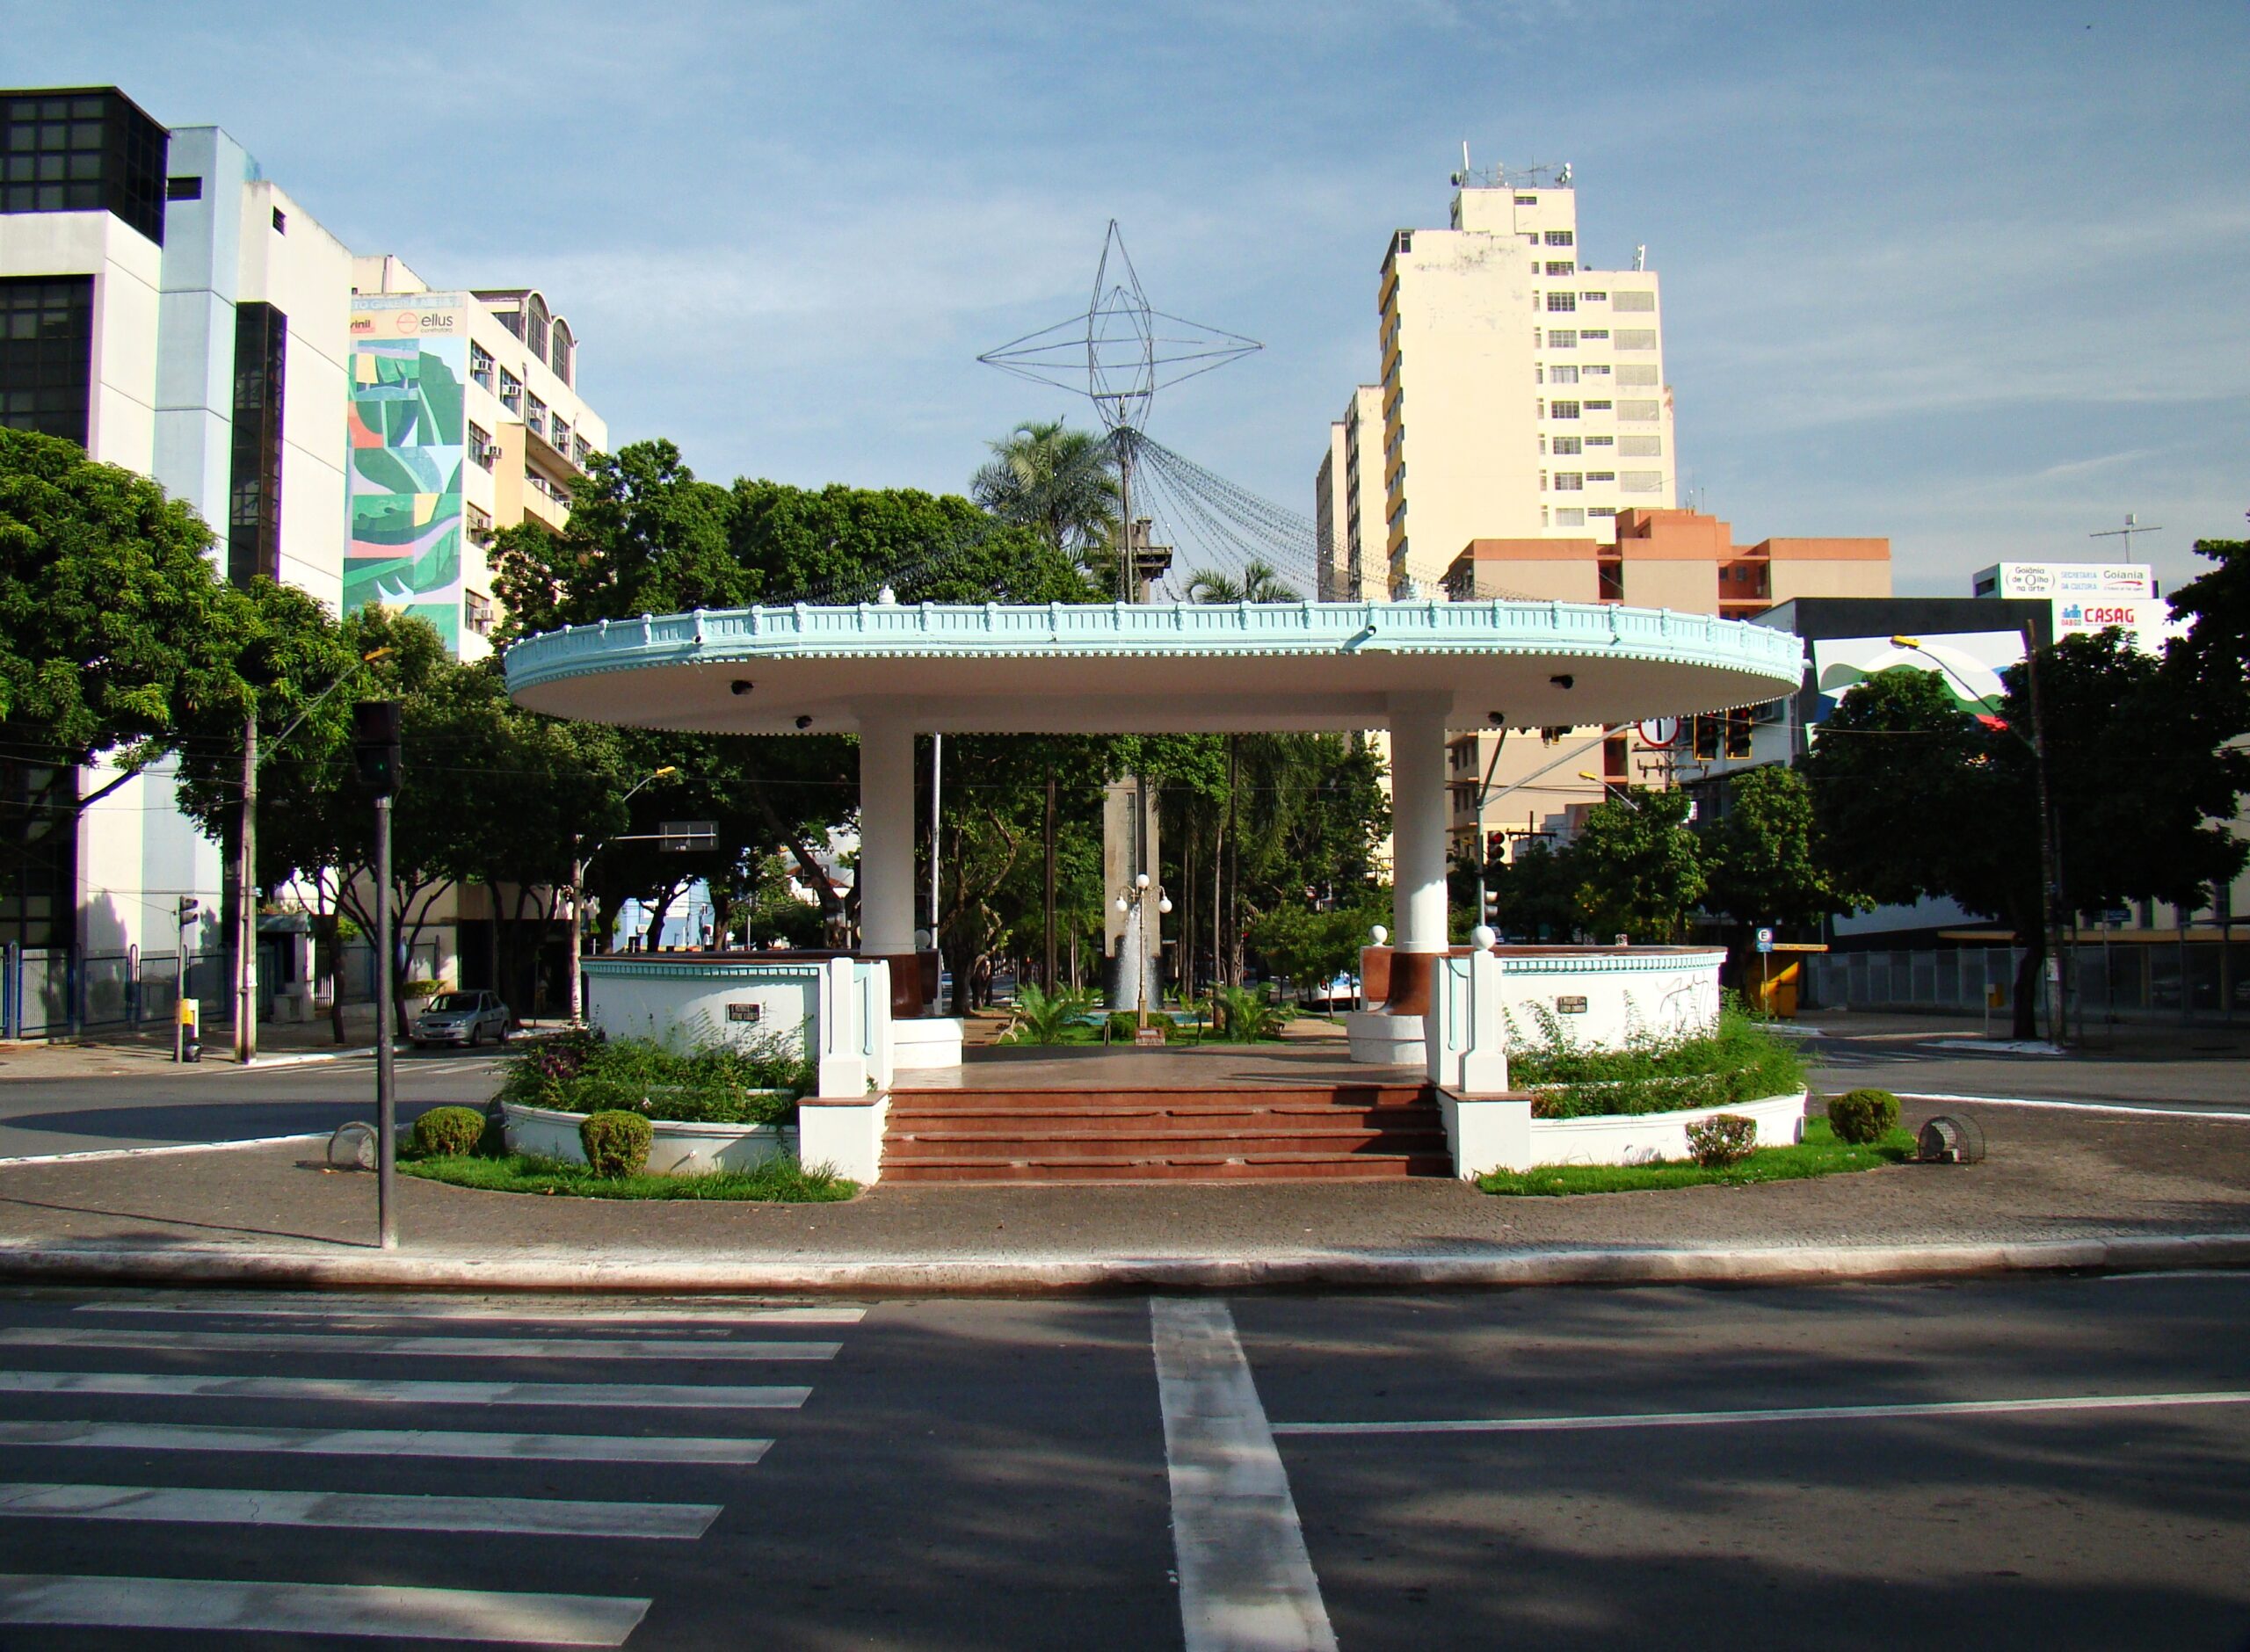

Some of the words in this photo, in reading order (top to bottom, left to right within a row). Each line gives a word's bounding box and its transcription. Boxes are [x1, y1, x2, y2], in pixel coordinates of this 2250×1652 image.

[422, 314, 454, 326] ellus
[2025, 575, 2049, 585] Olho
[2085, 608, 2134, 622] CASAG
